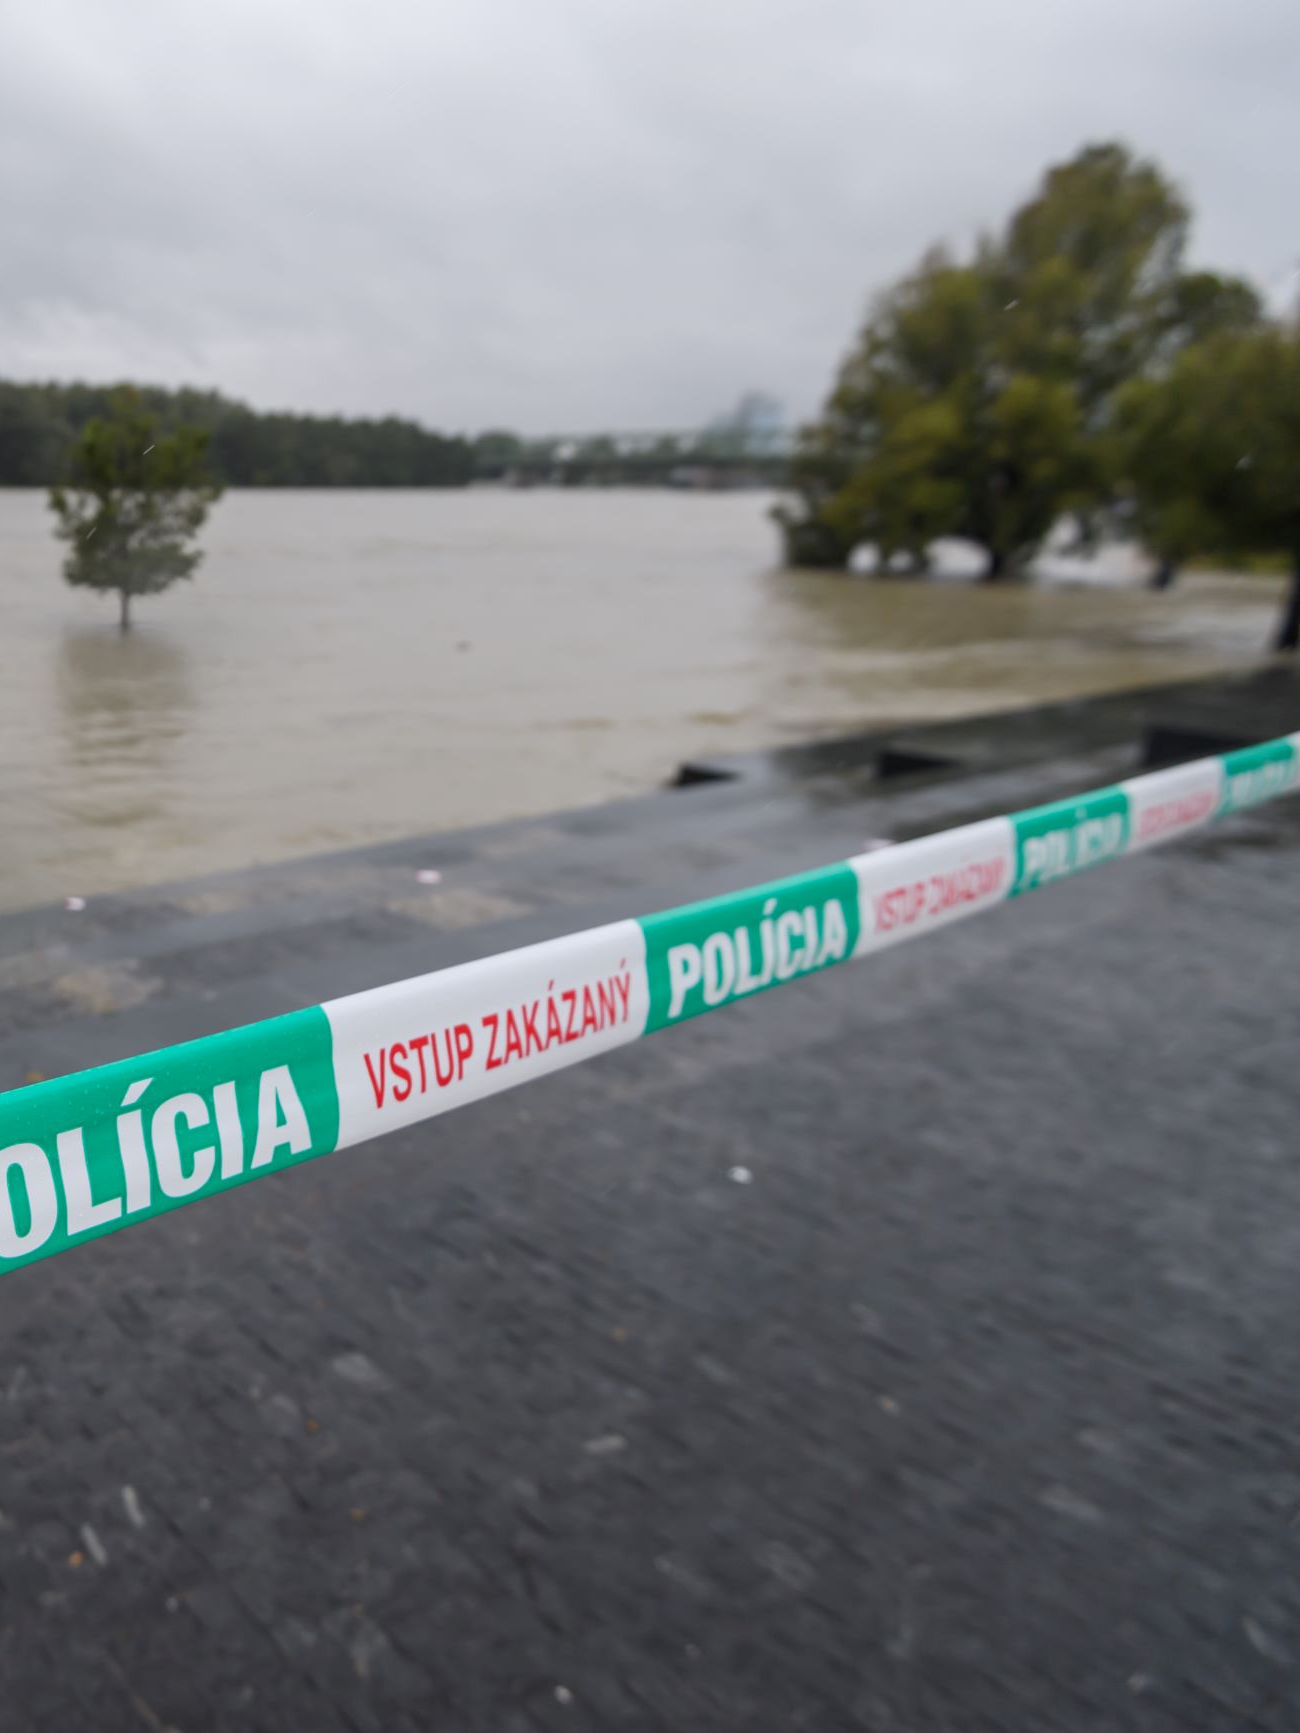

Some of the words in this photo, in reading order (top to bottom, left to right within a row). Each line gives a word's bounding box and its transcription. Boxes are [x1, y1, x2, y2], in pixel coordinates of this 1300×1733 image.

[363, 1021, 475, 1110] VSTUP
[479, 957, 632, 1072] ZAKÁZANÝ
[666, 897, 848, 1018] POLÍCIA
